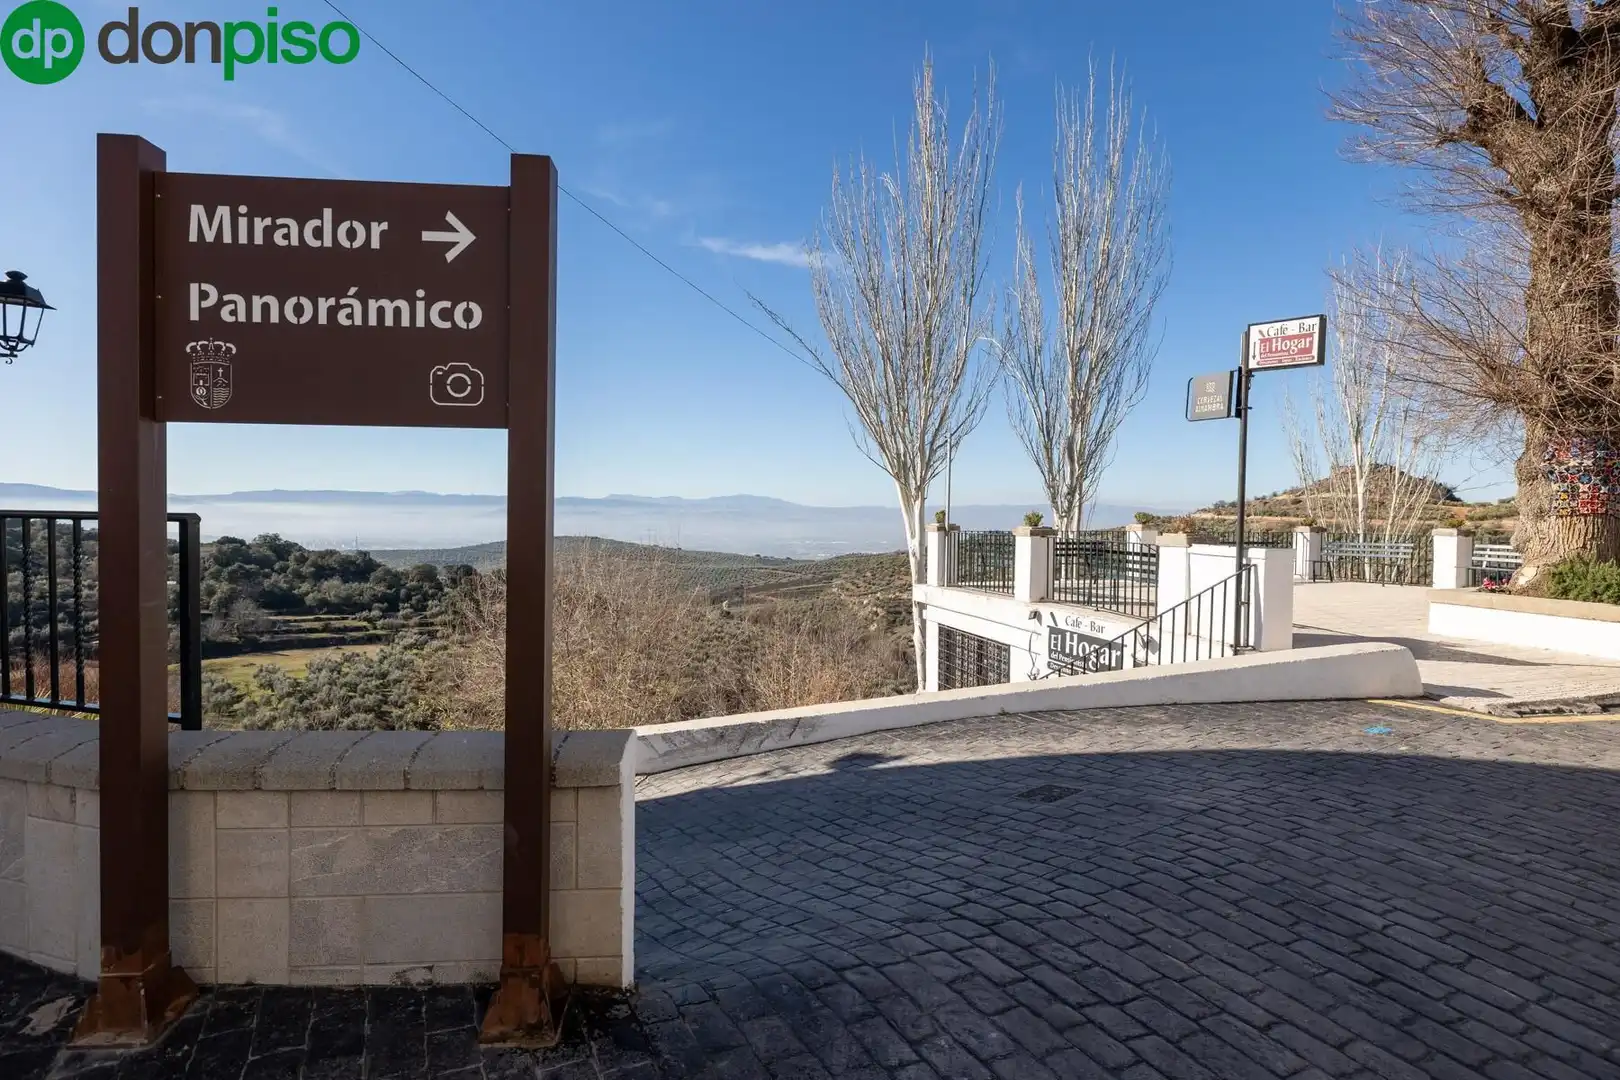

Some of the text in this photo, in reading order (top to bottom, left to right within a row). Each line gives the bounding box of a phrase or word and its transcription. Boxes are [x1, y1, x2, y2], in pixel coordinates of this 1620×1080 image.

[188, 204, 389, 250] Mirador
[188, 282, 484, 331] Panorámico
[1298, 321, 1318, 333] Bar
[1260, 341, 1270, 353] El
[1272, 336, 1313, 355] Hogar
[1090, 620, 1106, 634] Bar
[1050, 634, 1061, 651] El
[1065, 631, 1121, 671] Hogar
